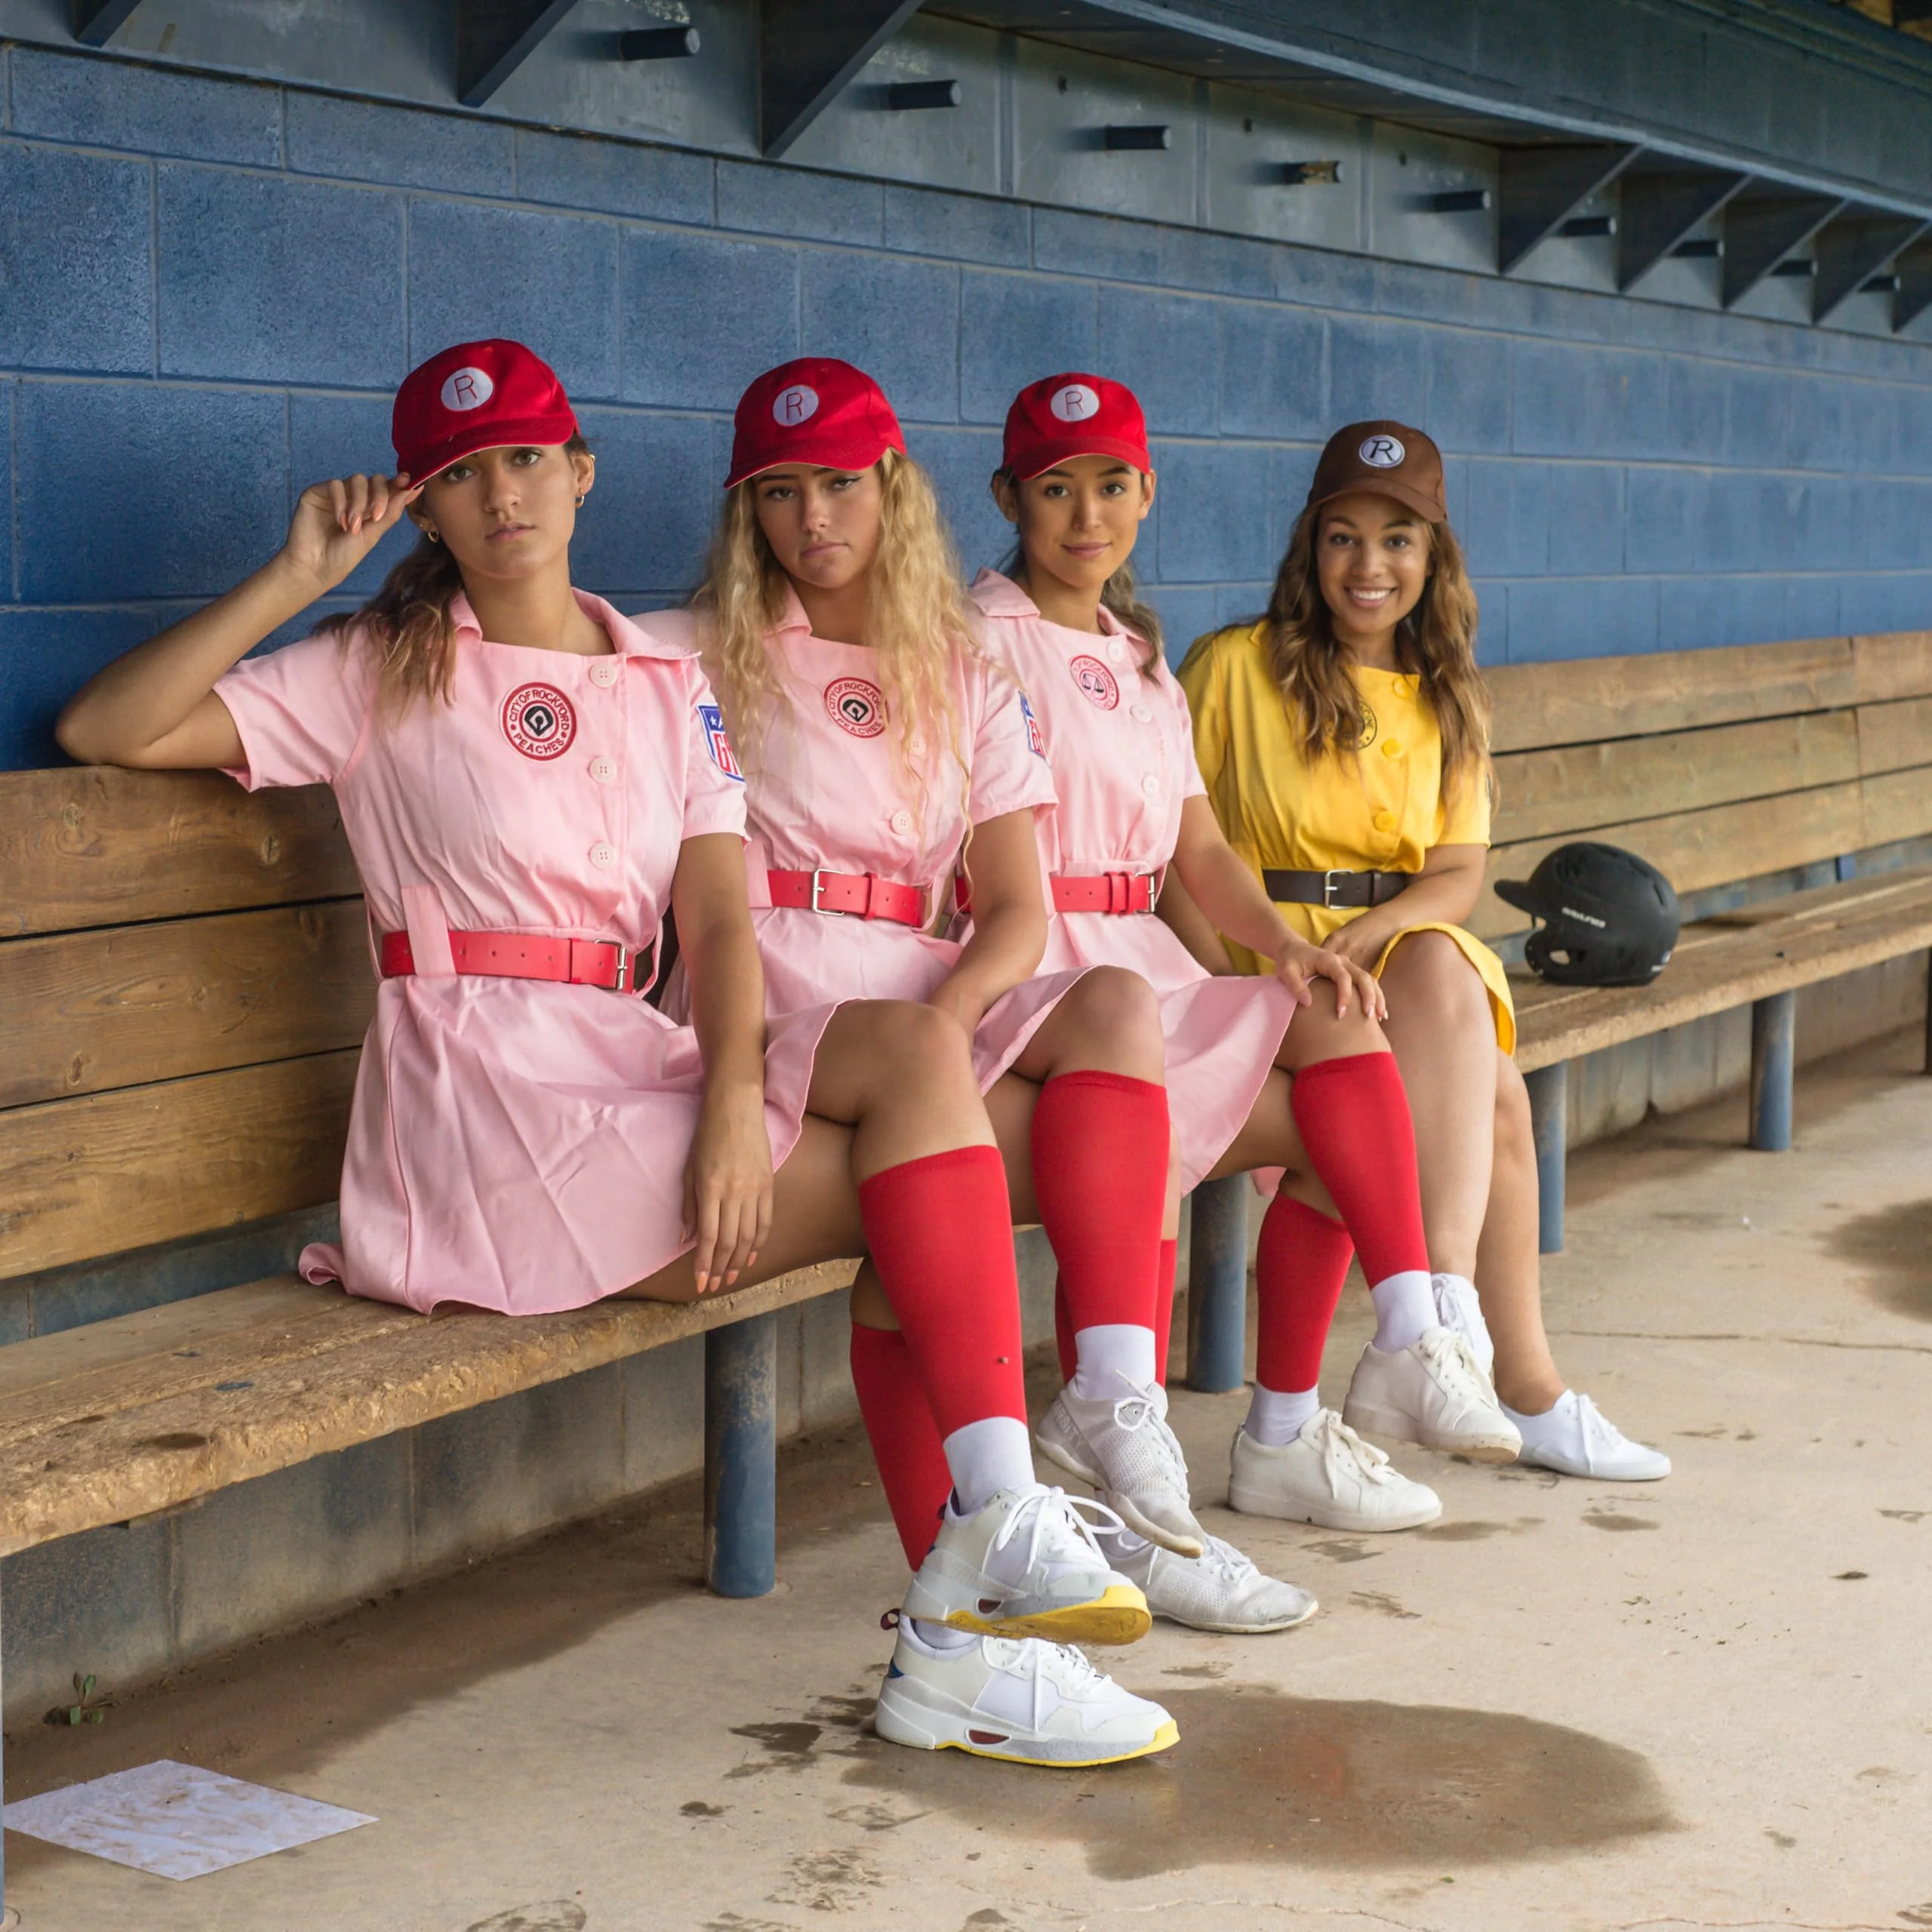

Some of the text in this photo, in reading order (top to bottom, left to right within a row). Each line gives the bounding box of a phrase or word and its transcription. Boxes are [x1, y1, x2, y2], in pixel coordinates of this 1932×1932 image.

[454, 375, 477, 405] R
[786, 392, 803, 420] R
[1065, 391, 1084, 416] R
[1369, 440, 1394, 461] R
[509, 689, 569, 731] CITY OF ROCKFORD
[513, 733, 565, 754] PEACHES
